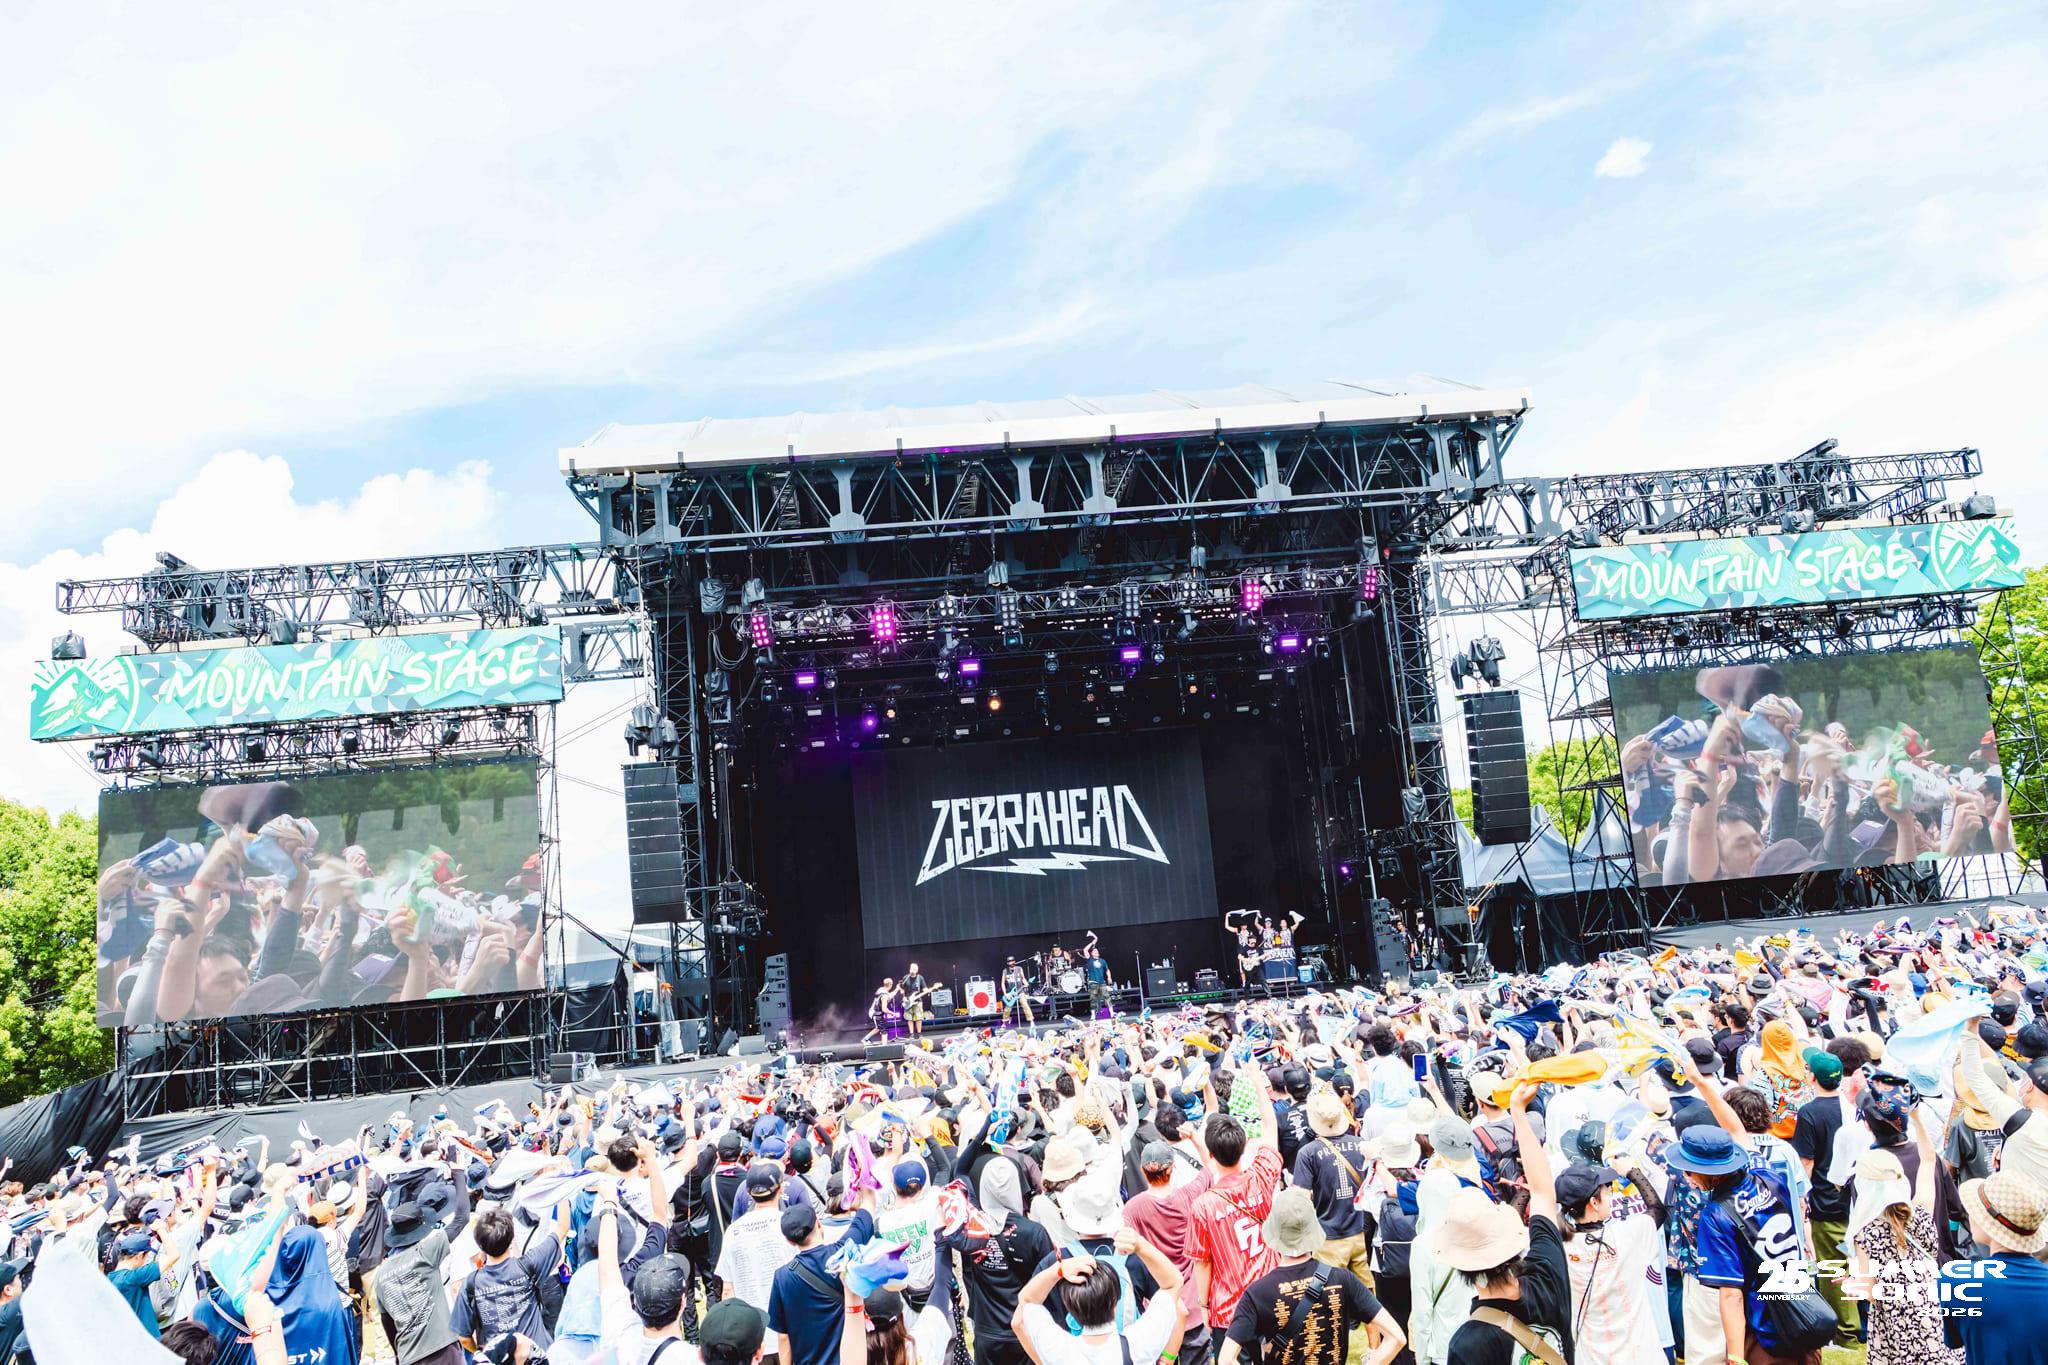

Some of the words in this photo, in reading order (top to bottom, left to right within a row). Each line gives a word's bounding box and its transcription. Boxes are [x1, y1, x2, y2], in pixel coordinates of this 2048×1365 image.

[1594, 554, 1782, 599] MOUNTAIN
[1794, 543, 1909, 586] STAGE
[165, 657, 389, 706] MOUNTAIN
[403, 645, 538, 693] STAGE
[915, 784, 1171, 886] ZEBRAHEAD
[1317, 1141, 1360, 1160] PRSLEY
[1333, 1158, 1353, 1200] 1
[1734, 1184, 1772, 1215] Gamba
[880, 1219, 927, 1244] REEN
[288, 1353, 308, 1365] ST
